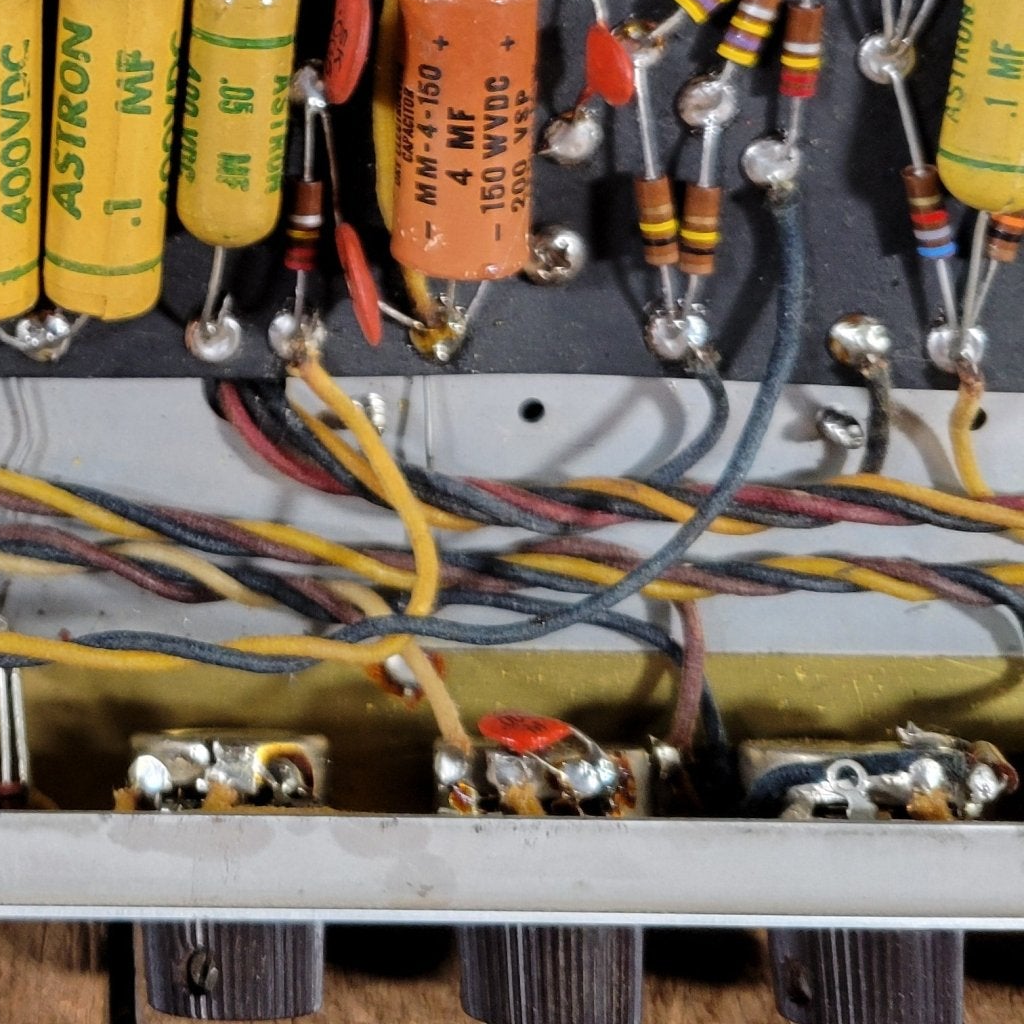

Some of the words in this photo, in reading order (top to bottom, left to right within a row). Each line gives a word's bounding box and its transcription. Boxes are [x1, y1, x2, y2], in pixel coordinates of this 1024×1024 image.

[114, 48, 155, 115] MF
[986, 39, 1024, 80] MF
[51, 16, 94, 221] ASTRON
[218, 76, 255, 115] .05
[482, 75, 511, 160] WVDC
[513, 89, 534, 145] VSP
[984, 97, 1019, 118] .1
[401, 86, 416, 164] CAPACITOR
[445, 106, 476, 150] MF
[215, 151, 252, 193] MF
[445, 167, 473, 187] 4
[480, 166, 507, 215] 150
[511, 159, 529, 214] 200
[103, 198, 143, 228] .1
